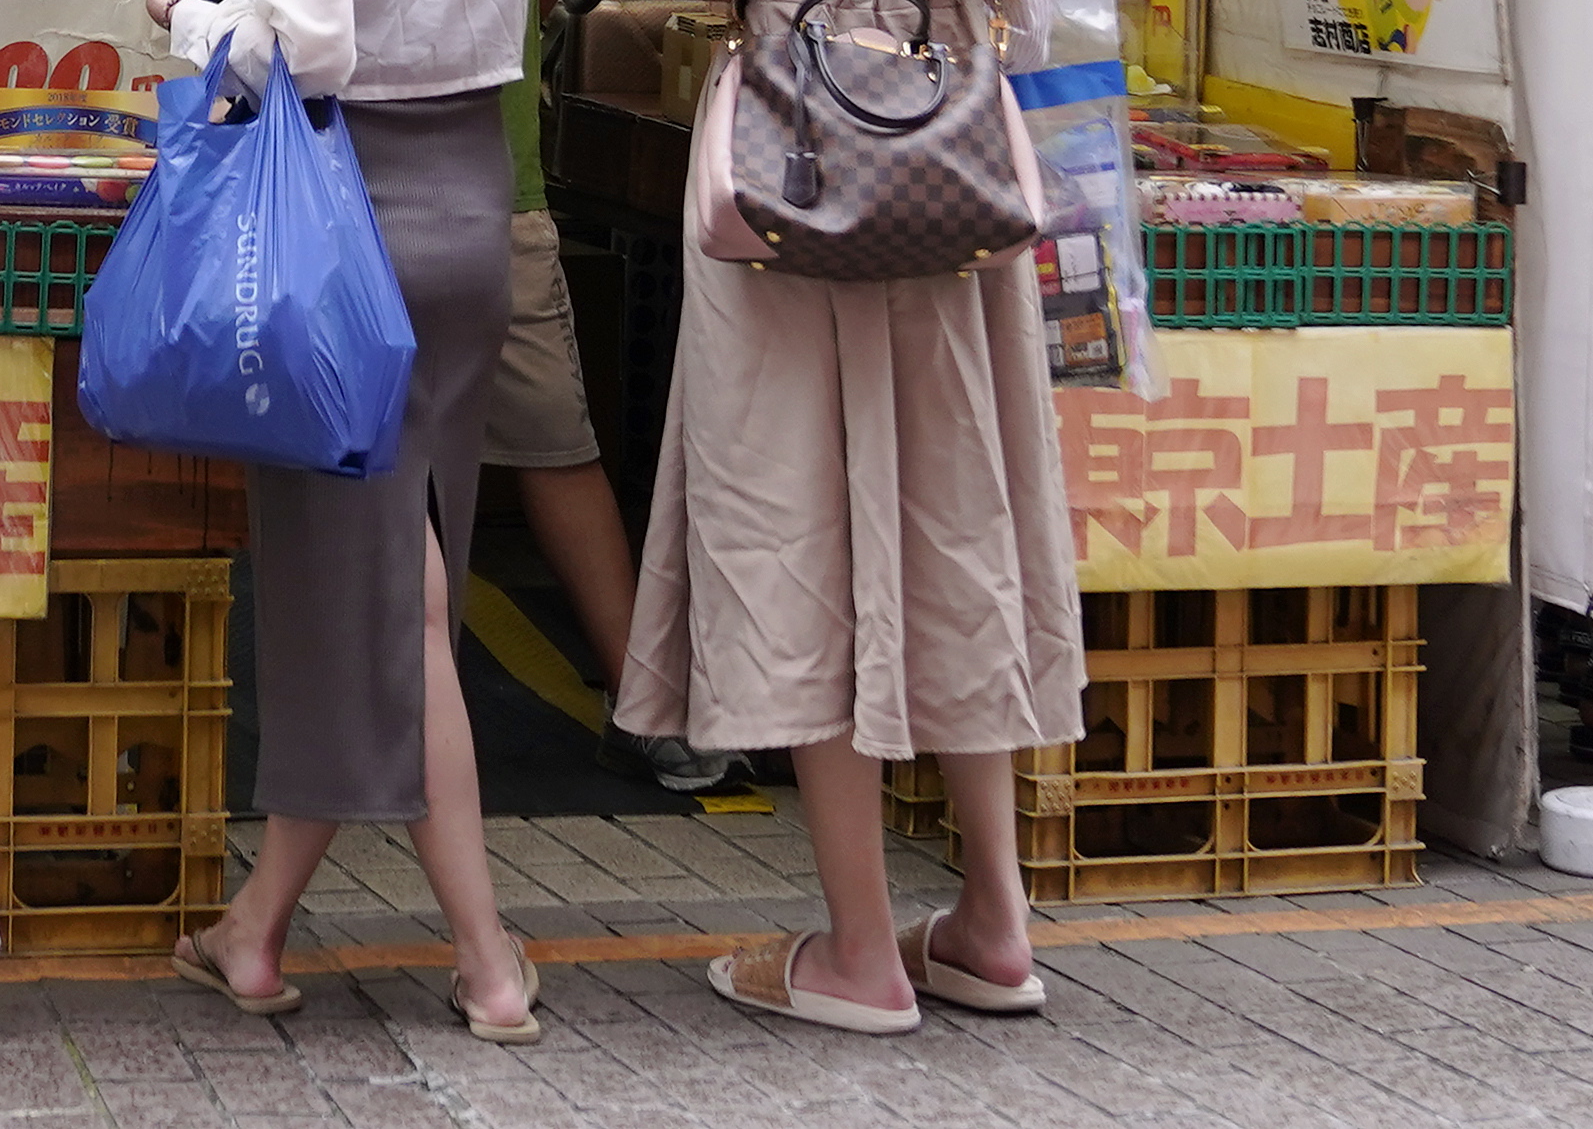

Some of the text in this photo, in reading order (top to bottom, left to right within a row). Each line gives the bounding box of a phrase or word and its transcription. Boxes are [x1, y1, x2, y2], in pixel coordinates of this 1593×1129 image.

[104, 113, 139, 138] 受賞
[234, 212, 264, 376] SUNDRUG
[1053, 374, 1513, 562] 東京土産
